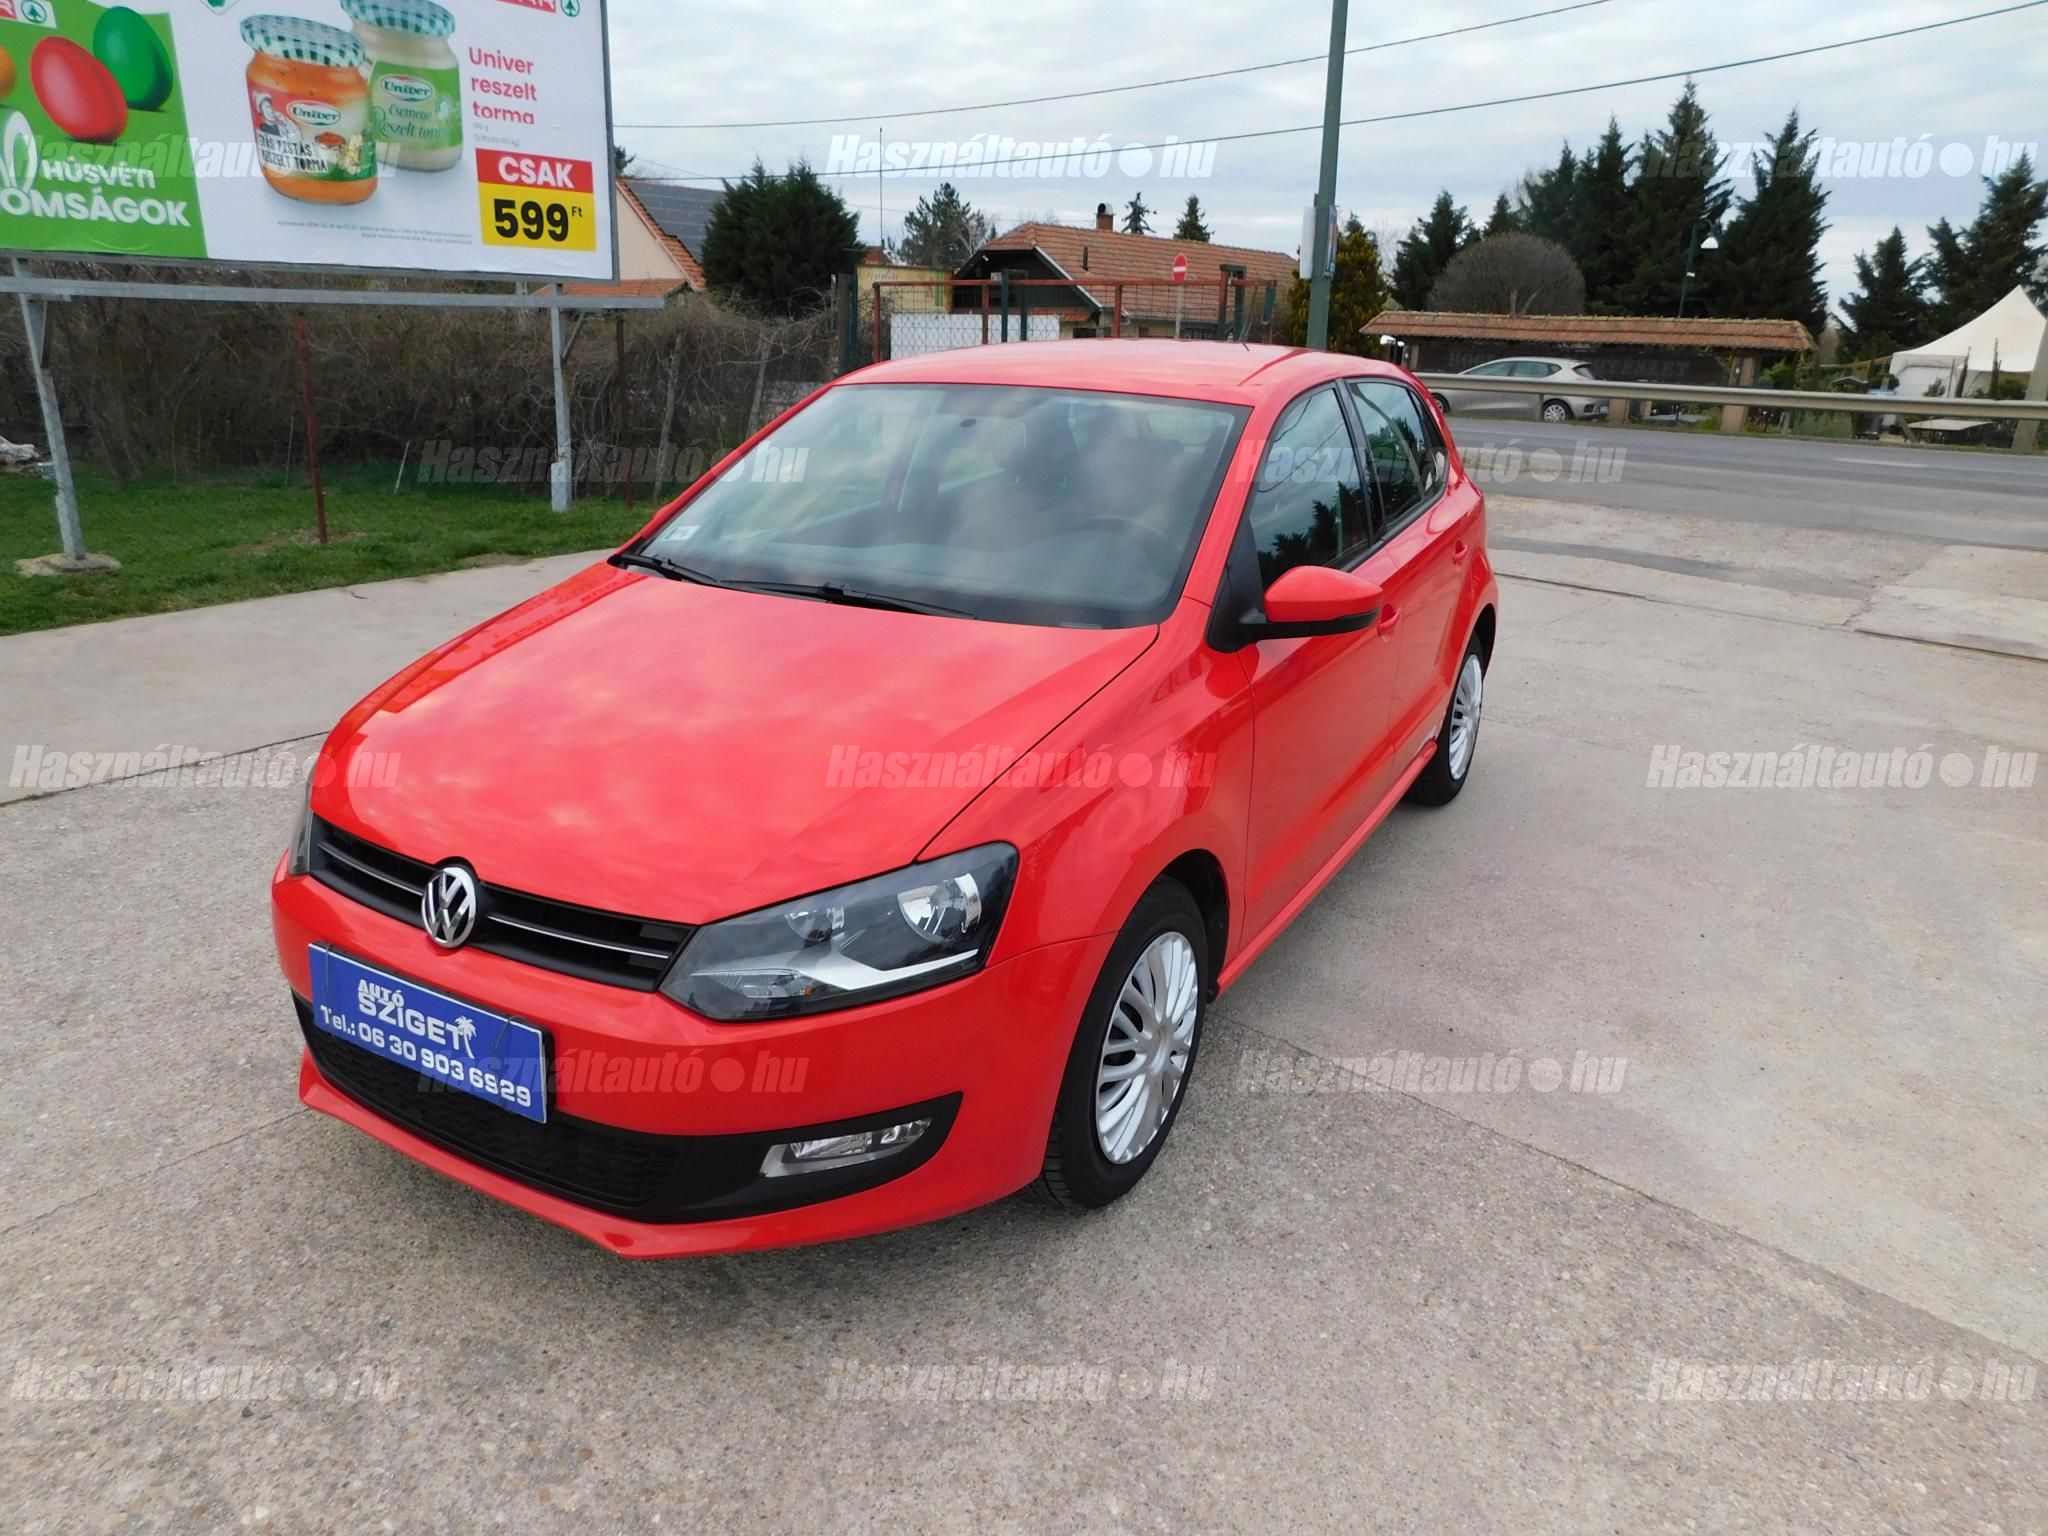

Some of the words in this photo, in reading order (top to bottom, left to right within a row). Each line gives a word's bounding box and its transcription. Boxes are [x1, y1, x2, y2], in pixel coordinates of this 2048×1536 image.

[469, 47, 534, 74] Univer
[471, 77, 538, 101] reszelt
[473, 101, 535, 125] torma
[498, 156, 575, 189] CSAK
[494, 198, 569, 242] 599
[571, 206, 583, 217] Ft
[357, 979, 405, 1008] AUTÓ
[320, 1005, 356, 1036] Tel.:
[358, 1022, 385, 1048] 06
[389, 1036, 416, 1061] 30
[421, 1048, 464, 1081] 903
[469, 1067, 531, 1108] 6929
